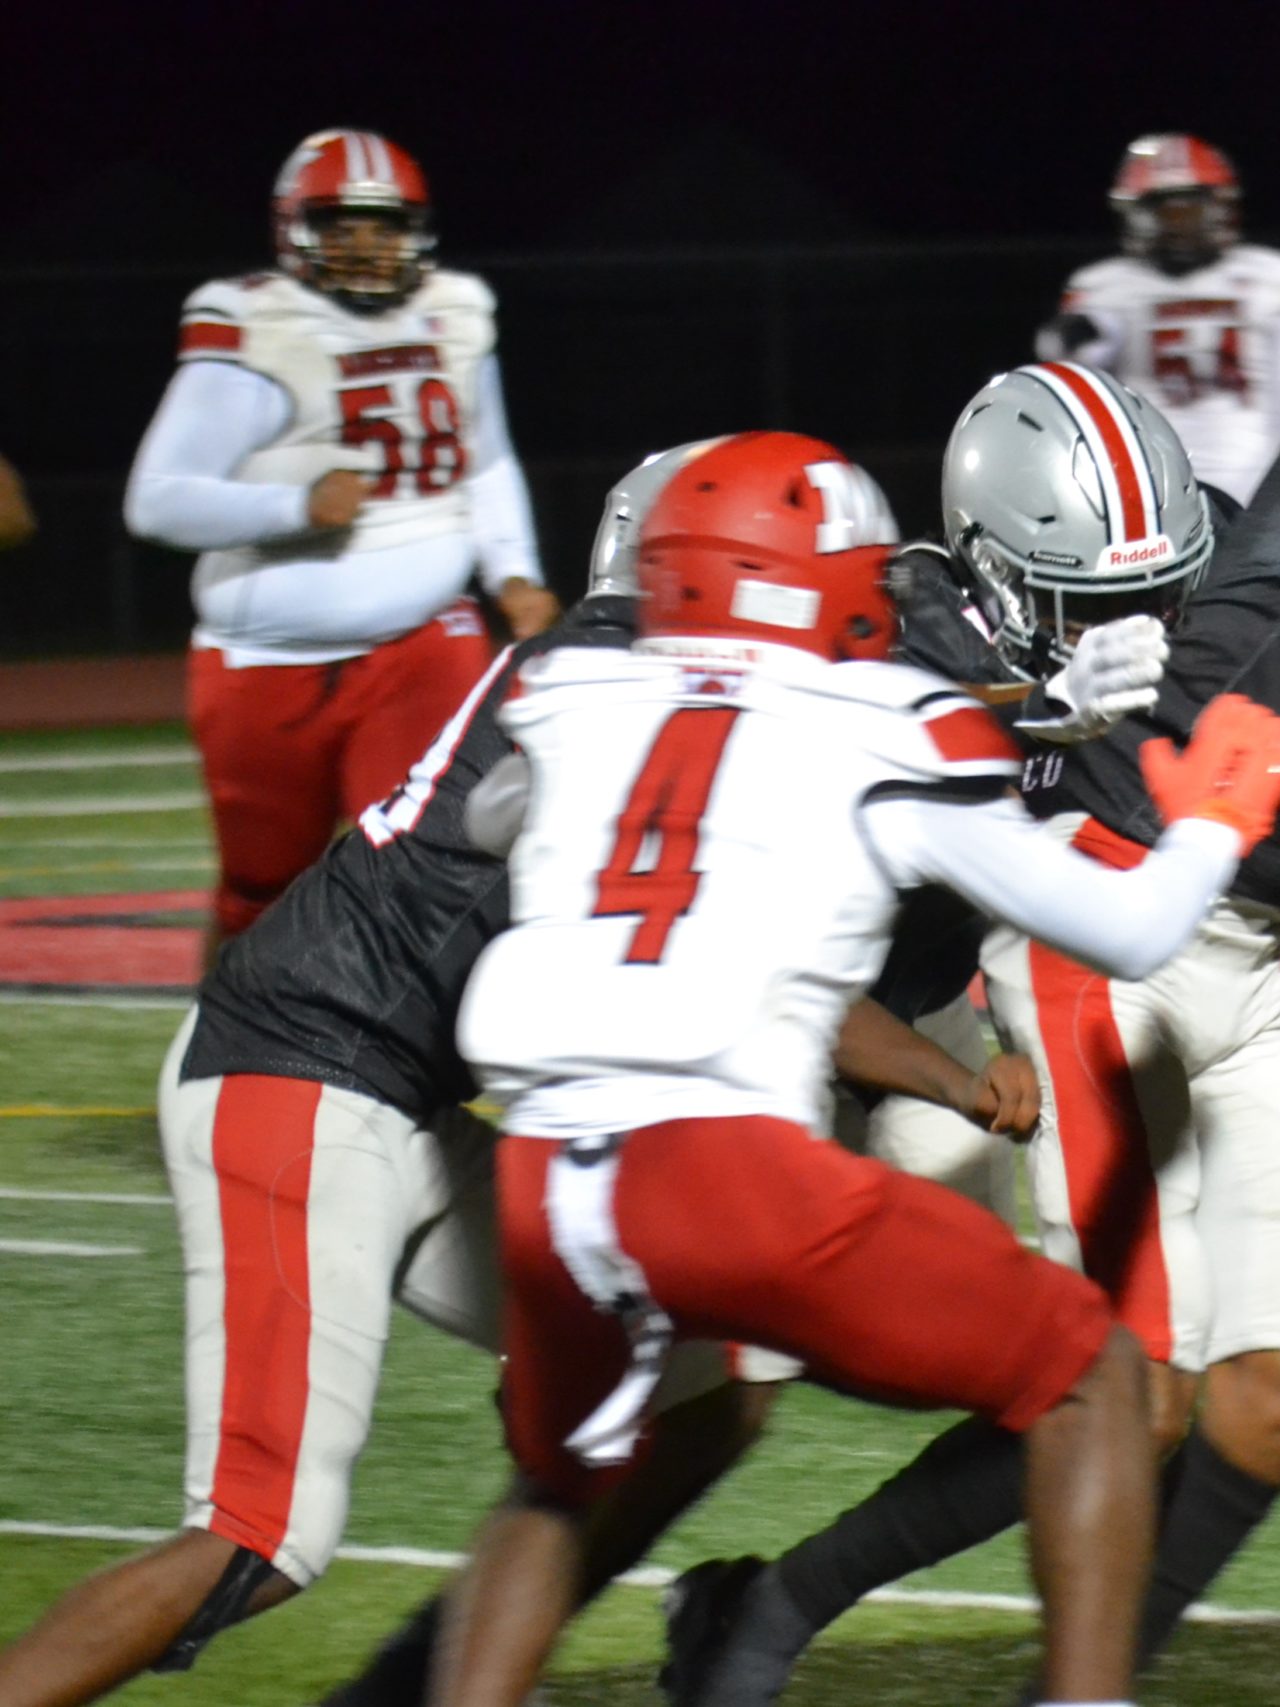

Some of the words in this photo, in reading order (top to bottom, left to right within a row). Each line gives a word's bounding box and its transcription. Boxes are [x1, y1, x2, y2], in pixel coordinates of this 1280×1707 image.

[336, 378, 468, 499] 58
[1110, 541, 1168, 566] Riddell
[588, 706, 742, 966] 4
